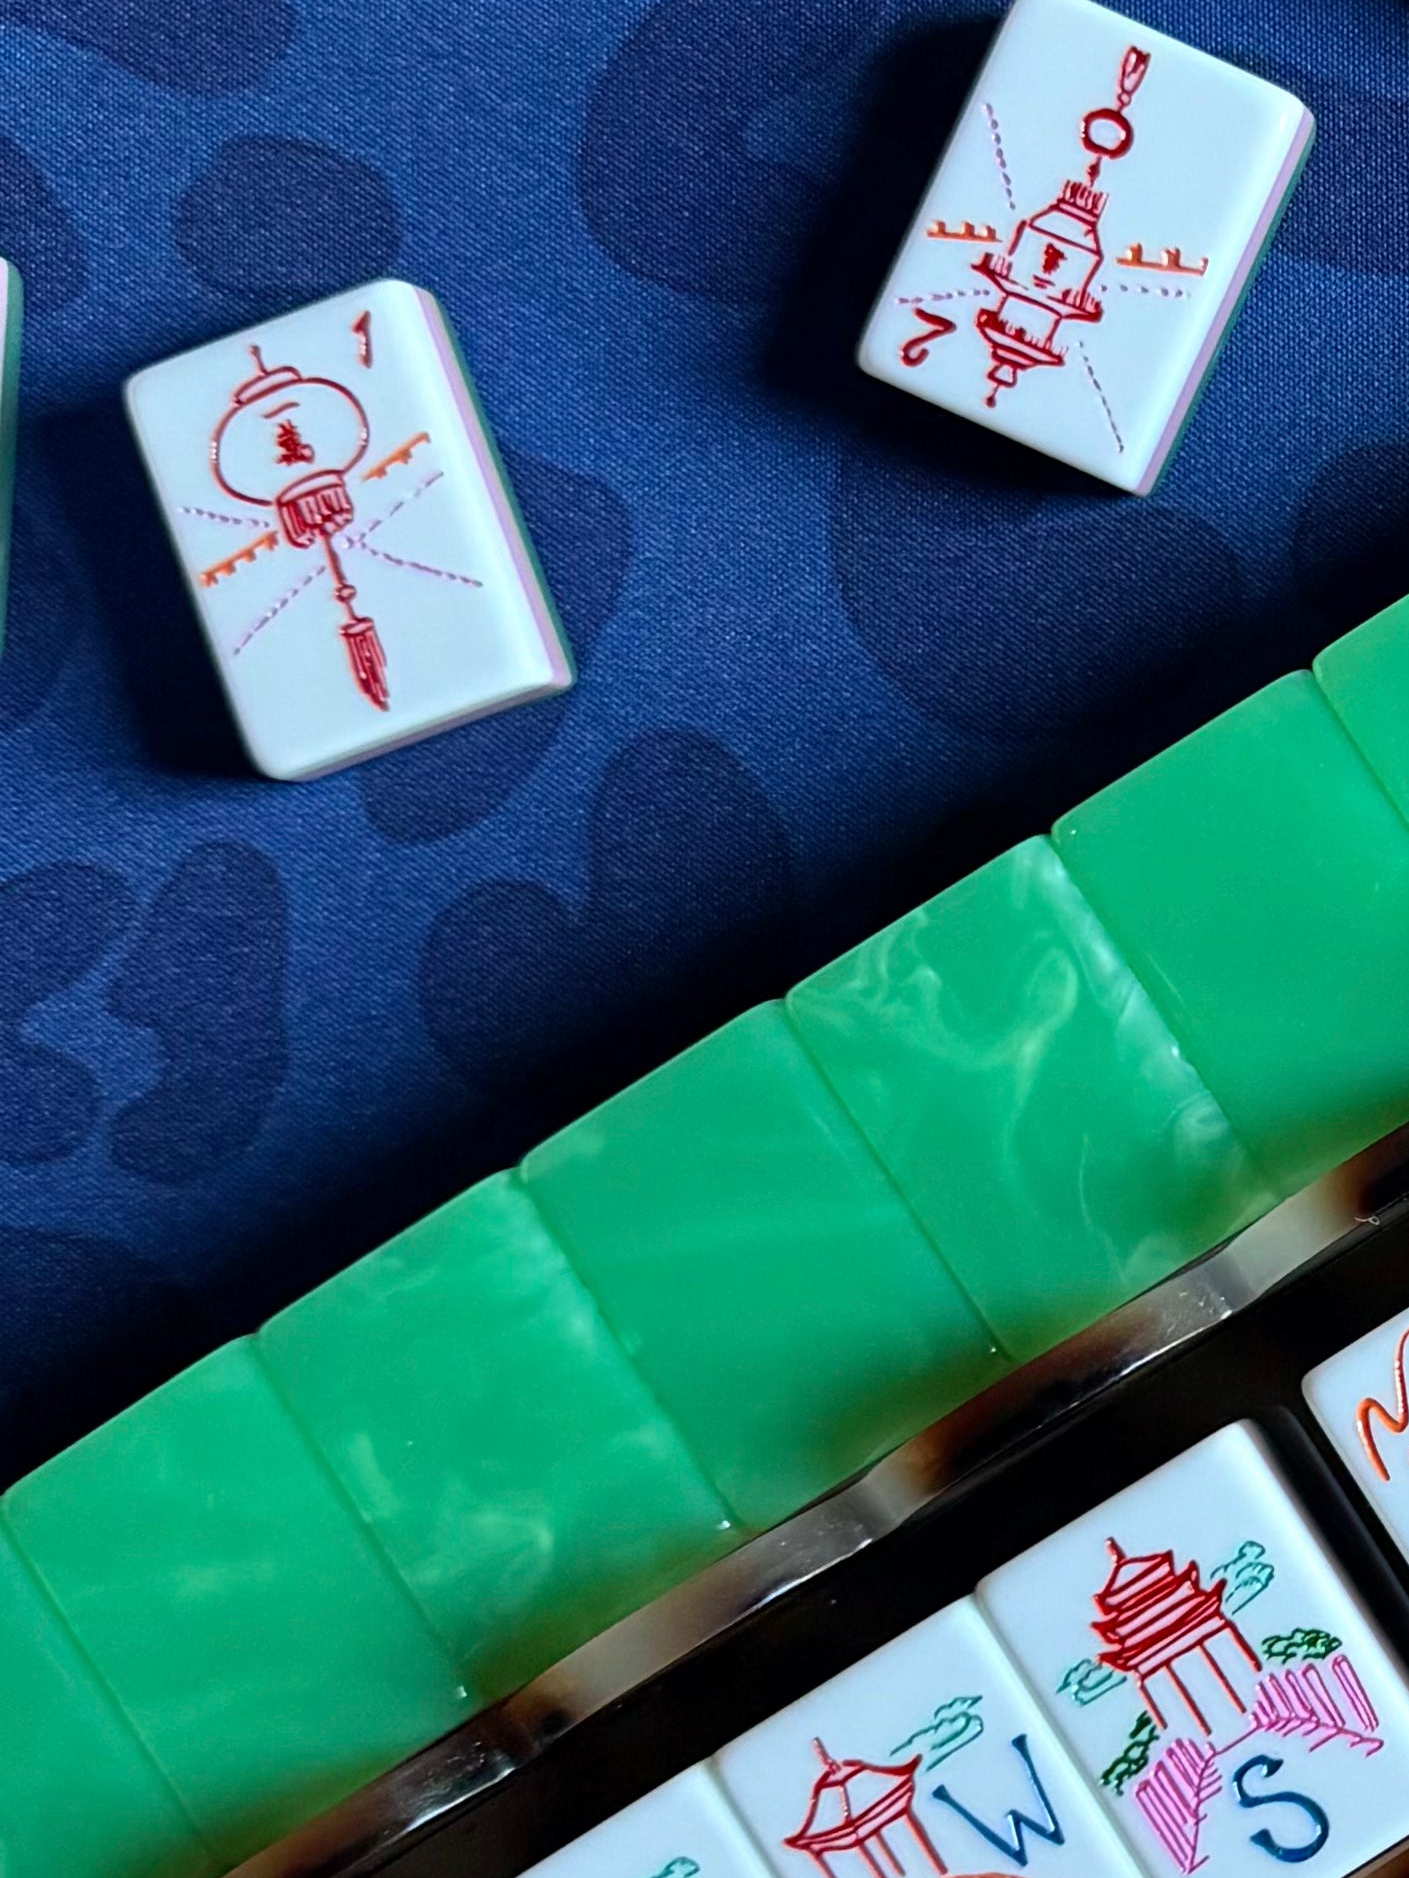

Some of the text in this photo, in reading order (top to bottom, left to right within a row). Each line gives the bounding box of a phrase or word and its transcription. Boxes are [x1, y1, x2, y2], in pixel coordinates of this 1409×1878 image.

[352, 311, 372, 368] 1
[900, 307, 957, 368] 2
[931, 1732, 1067, 1867] W
[1232, 1754, 1330, 1863] S
